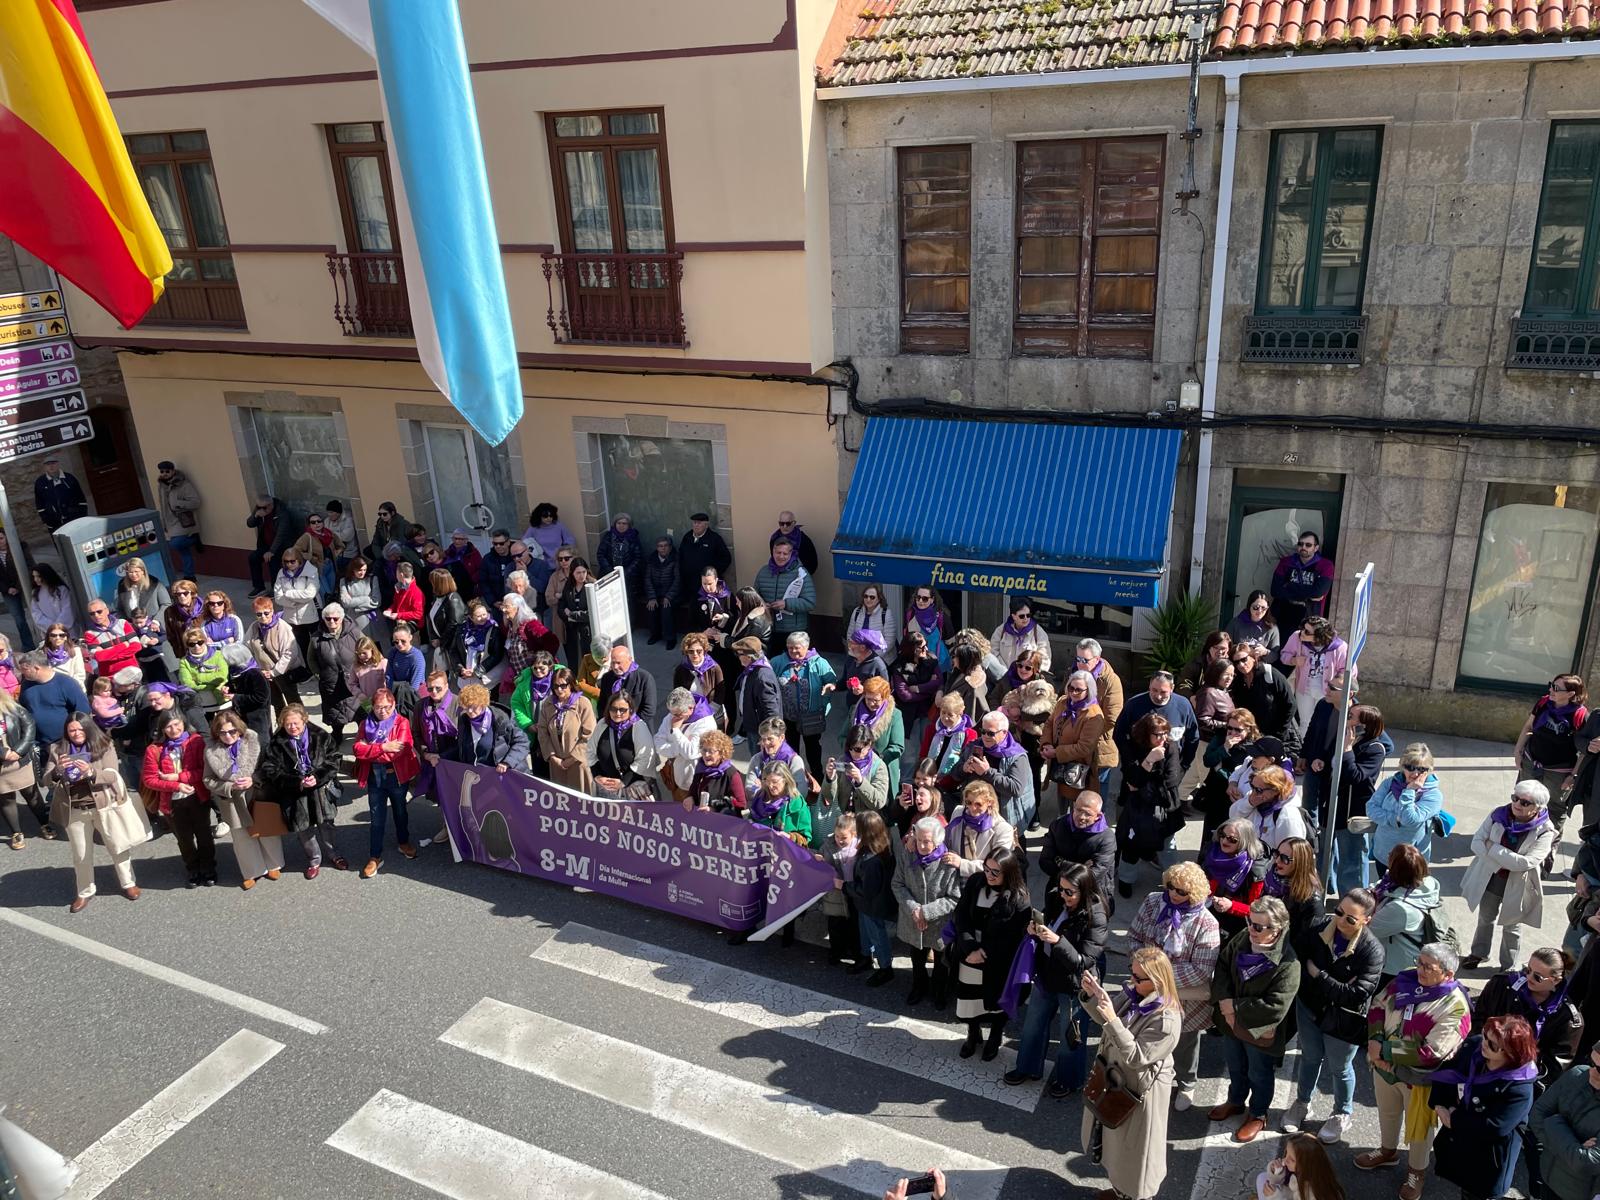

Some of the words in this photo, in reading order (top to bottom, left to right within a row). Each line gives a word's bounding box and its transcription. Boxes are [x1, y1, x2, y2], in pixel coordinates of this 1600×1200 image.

[16, 379, 41, 389] Aguiar
[16, 441, 46, 454] Pedras
[930, 562, 965, 586] fina
[970, 572, 1048, 594] campaña
[523, 788, 570, 812] POR
[577, 796, 675, 838] TODALAS
[680, 821, 795, 889] MULLERS,
[539, 815, 611, 845] POLOS
[616, 829, 682, 867] NOSOS
[687, 852, 781, 905] DEREITS
[540, 848, 591, 881] 8-M
[598, 873, 607, 882] da
[608, 875, 629, 888] Muller
[611, 866, 652, 885] Internacional
